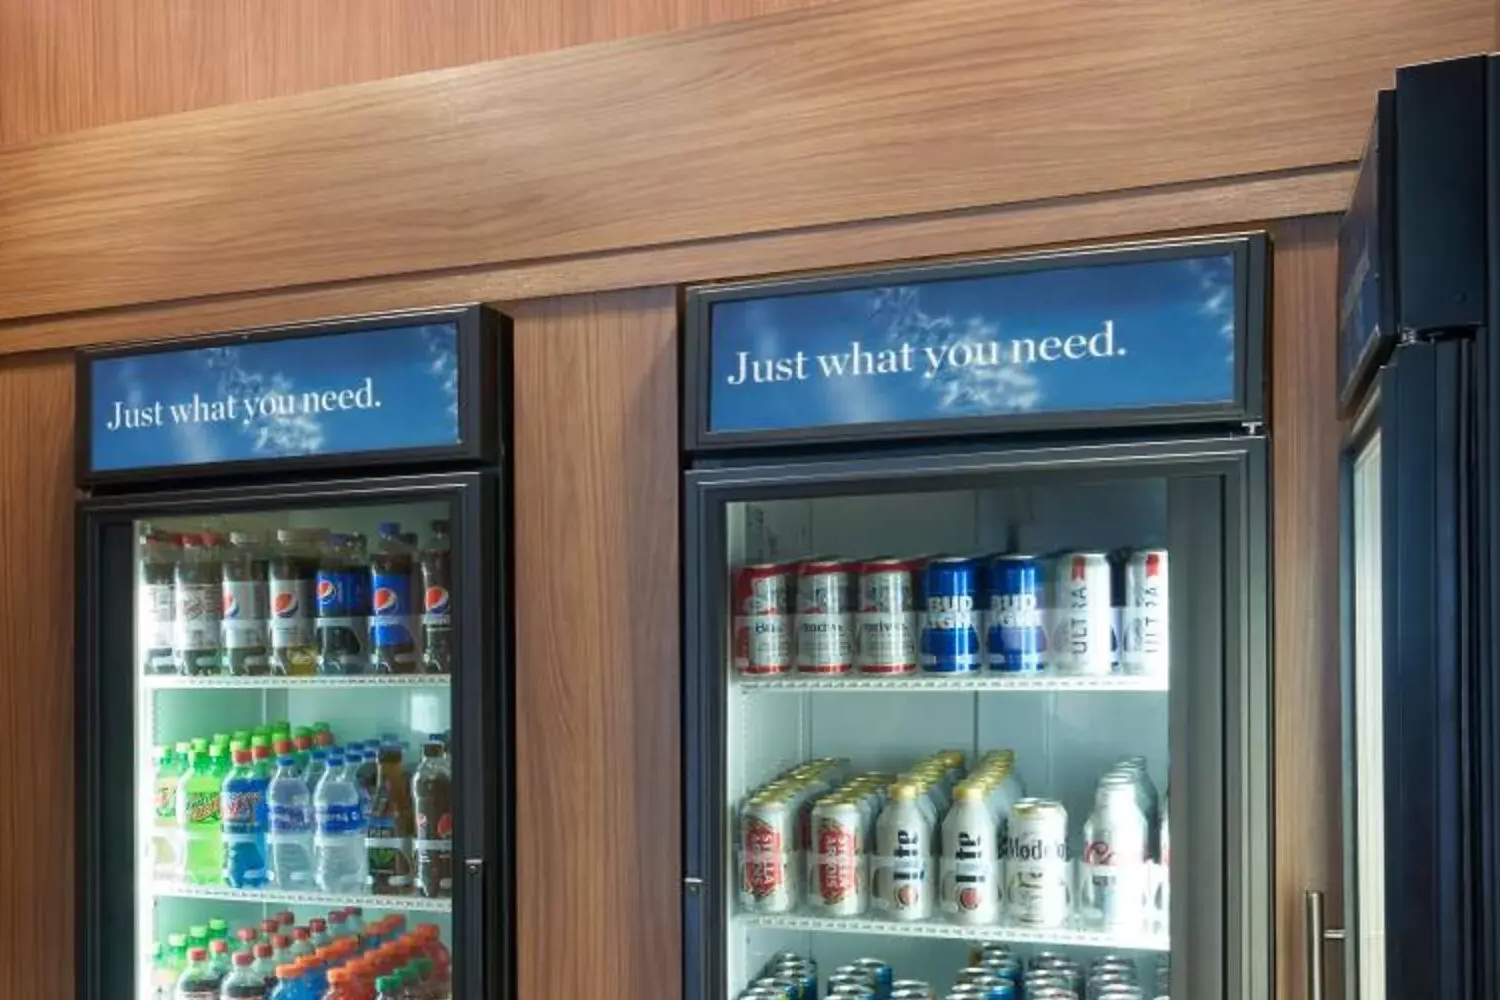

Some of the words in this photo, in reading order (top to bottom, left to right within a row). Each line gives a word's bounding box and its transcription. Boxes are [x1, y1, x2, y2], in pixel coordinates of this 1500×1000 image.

[727, 351, 809, 386] Just
[816, 342, 912, 378] what
[922, 341, 998, 379] you
[1011, 320, 1128, 363] need.
[107, 402, 162, 431] Just
[170, 393, 236, 425] what
[243, 395, 296, 425] you
[302, 377, 382, 413] need.
